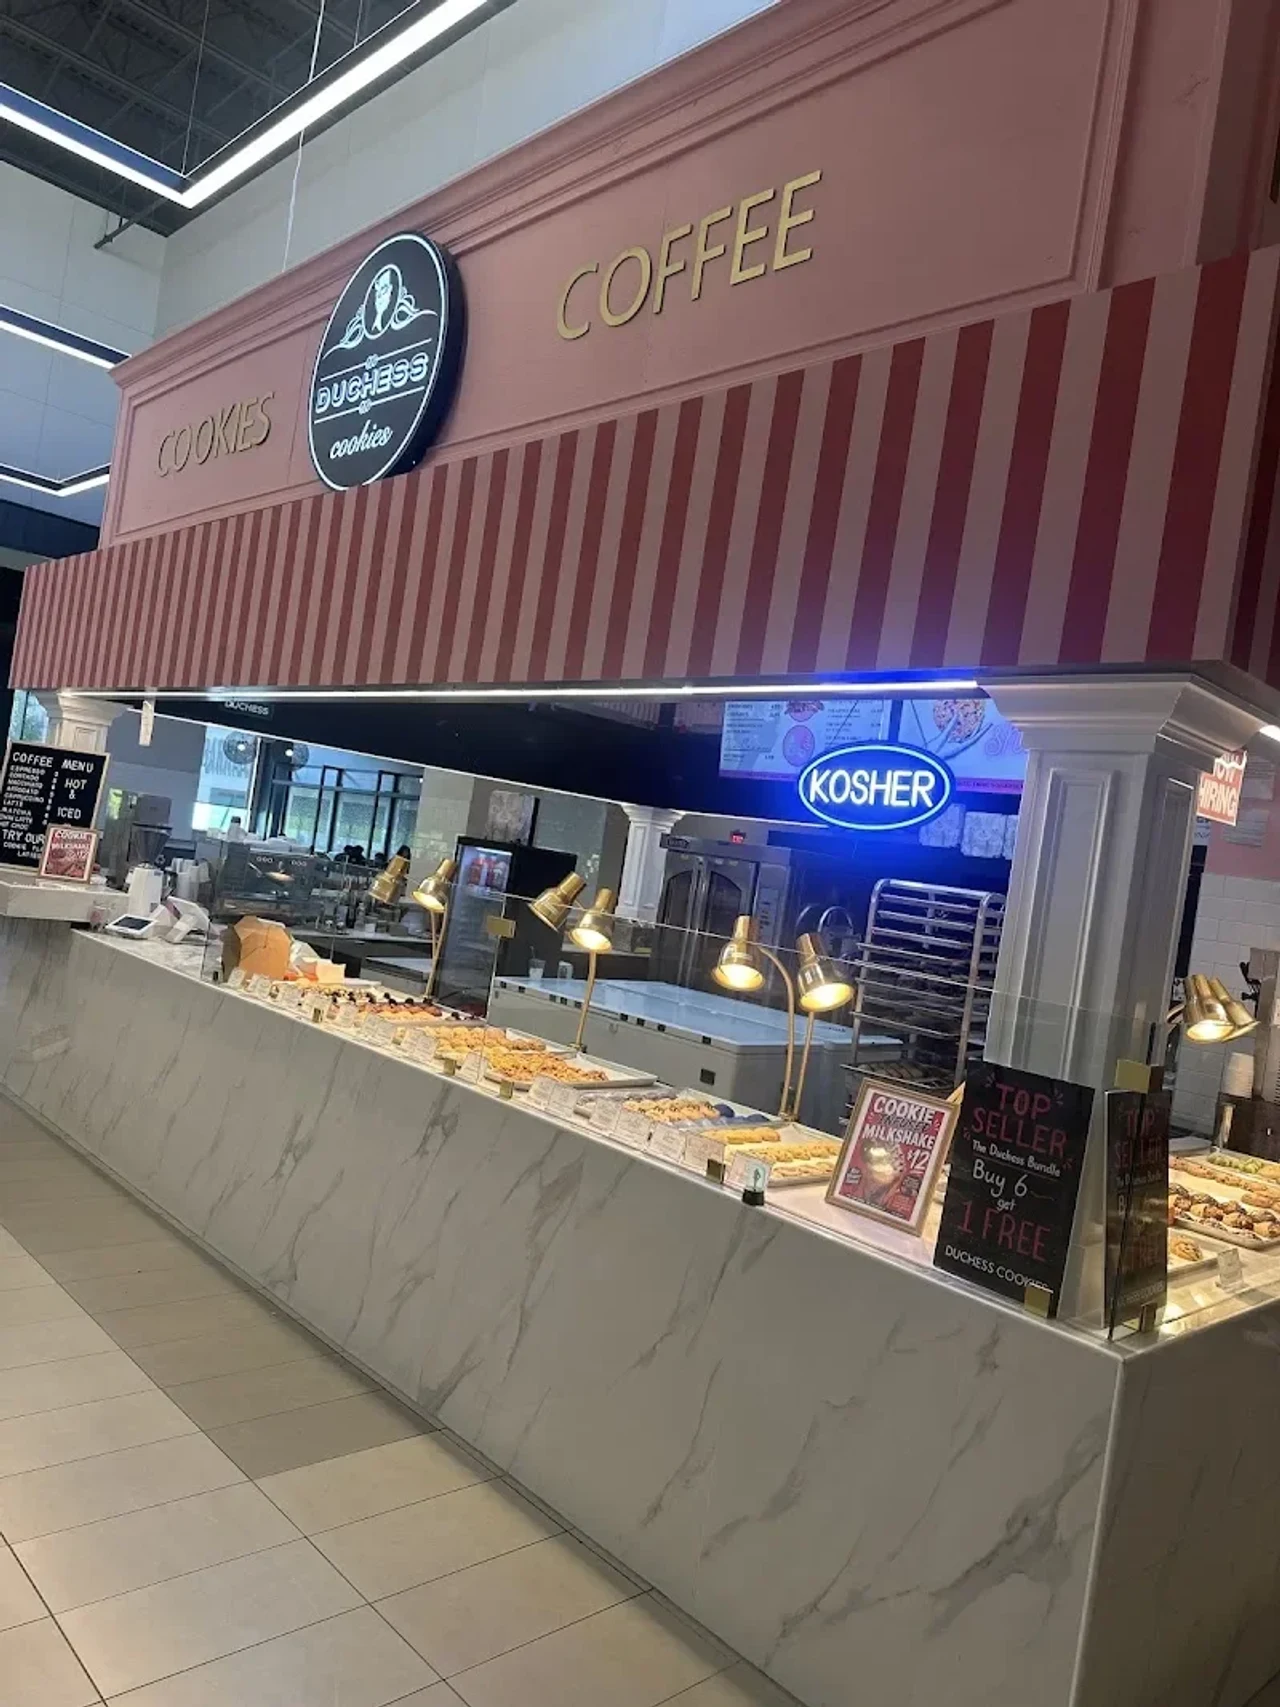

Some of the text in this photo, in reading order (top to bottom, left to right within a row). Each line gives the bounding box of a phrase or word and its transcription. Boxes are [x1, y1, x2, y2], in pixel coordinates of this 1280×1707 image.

[556, 170, 822, 340] COFFEE
[315, 352, 429, 414] DUCHESS
[156, 391, 275, 477] COOKIES
[329, 419, 393, 460] cookies
[12, 751, 94, 773] COFFEE MENU
[64, 778, 87, 790] HOT
[68, 789, 76, 799] &
[808, 769, 936, 808] KOSHER
[1199, 779, 1238, 818] HIRING
[57, 806, 81, 820] ICED
[2, 829, 45, 845] TRY OUR
[873, 1096, 936, 1124] COOKIE
[996, 1083, 1052, 1120] TOP
[862, 1123, 936, 1150] MILKSHAKE
[972, 1107, 1068, 1158] SELLER
[907, 1149, 931, 1170] $12
[973, 1139, 1060, 1177] The Duchess Bundle
[973, 1158, 1029, 1198] Buy 6
[997, 1198, 1017, 1213] get
[957, 1200, 973, 1234] 1
[982, 1207, 1051, 1263] FREE
[945, 1244, 995, 1274] DUCHESS
